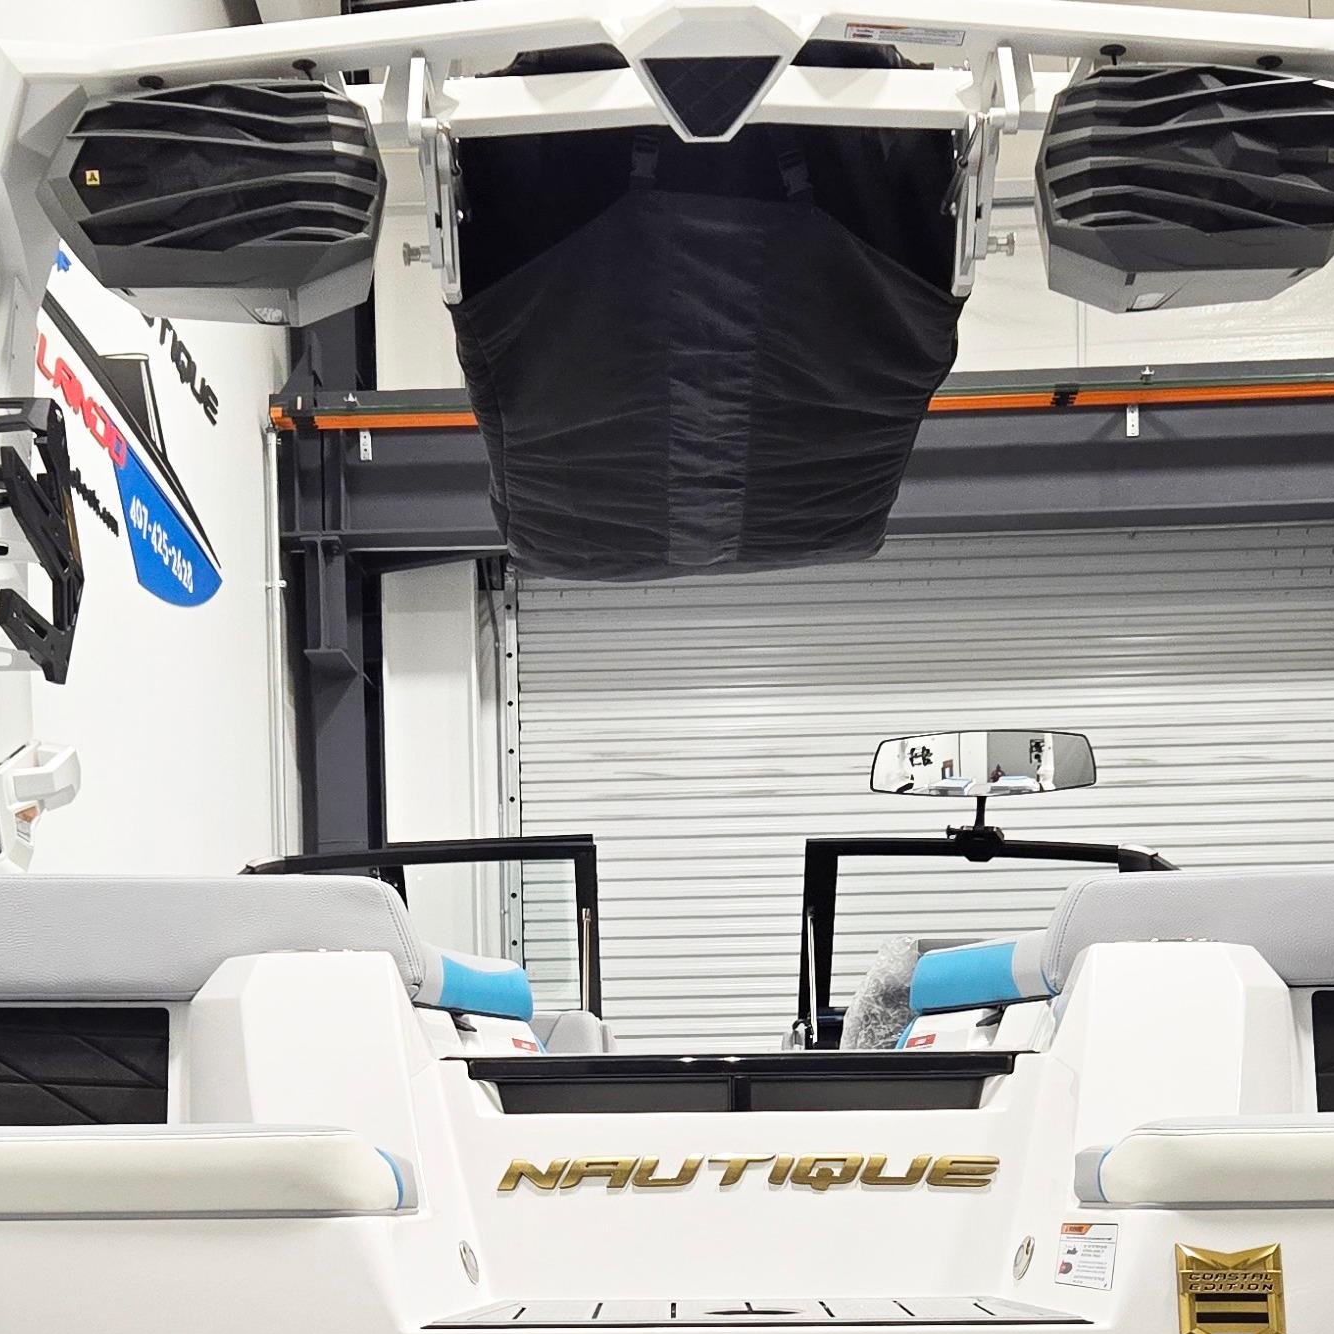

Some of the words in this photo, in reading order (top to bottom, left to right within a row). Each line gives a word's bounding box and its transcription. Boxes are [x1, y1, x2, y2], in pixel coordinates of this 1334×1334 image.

[142, 316, 219, 426] TIQUE
[36, 333, 127, 469] LANDO
[497, 1152, 999, 1191] NAUTIQUE
[1189, 1272, 1272, 1281] COASTAL
[1189, 1283, 1274, 1291] EDITION
